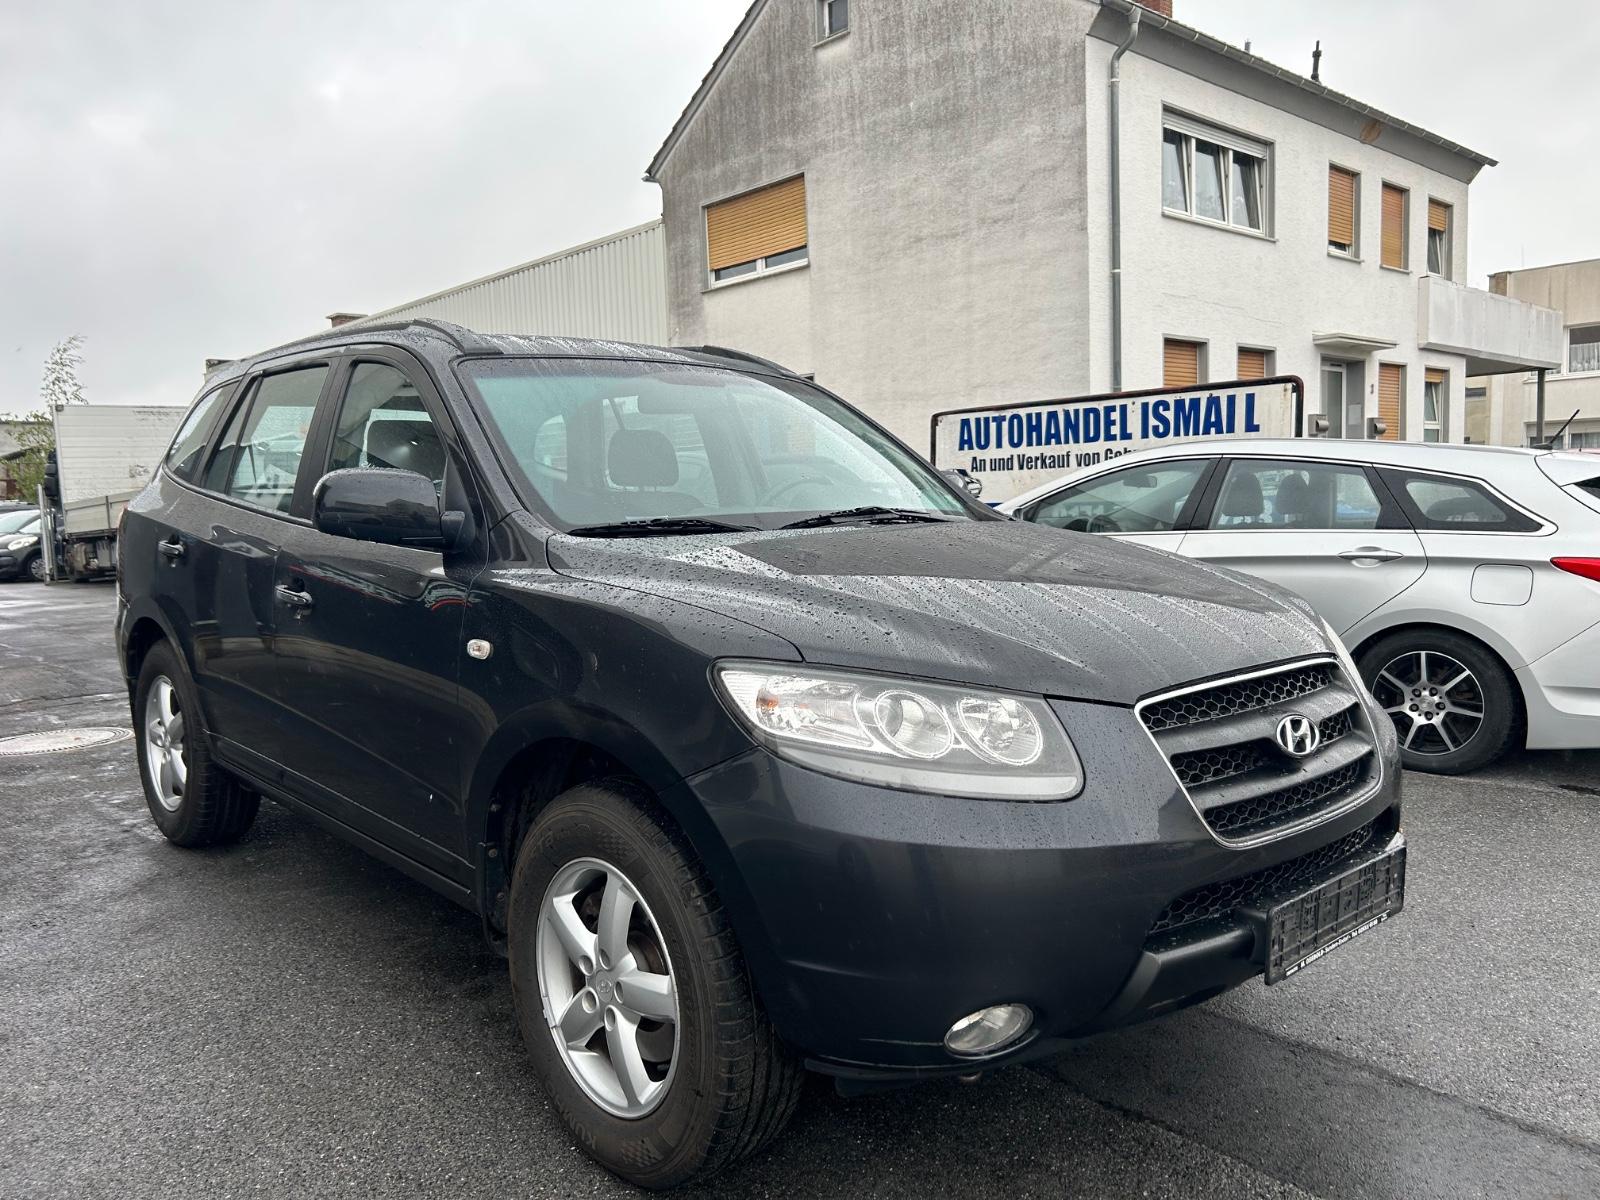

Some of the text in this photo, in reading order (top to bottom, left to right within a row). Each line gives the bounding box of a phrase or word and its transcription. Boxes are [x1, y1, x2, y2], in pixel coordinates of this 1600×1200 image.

[958, 392, 1260, 451] AUTOHANDEL ISMAIL
[971, 456, 986, 472] An
[990, 454, 1013, 472] und
[1017, 451, 1070, 470] Verkauf
[1075, 451, 1100, 467] von
